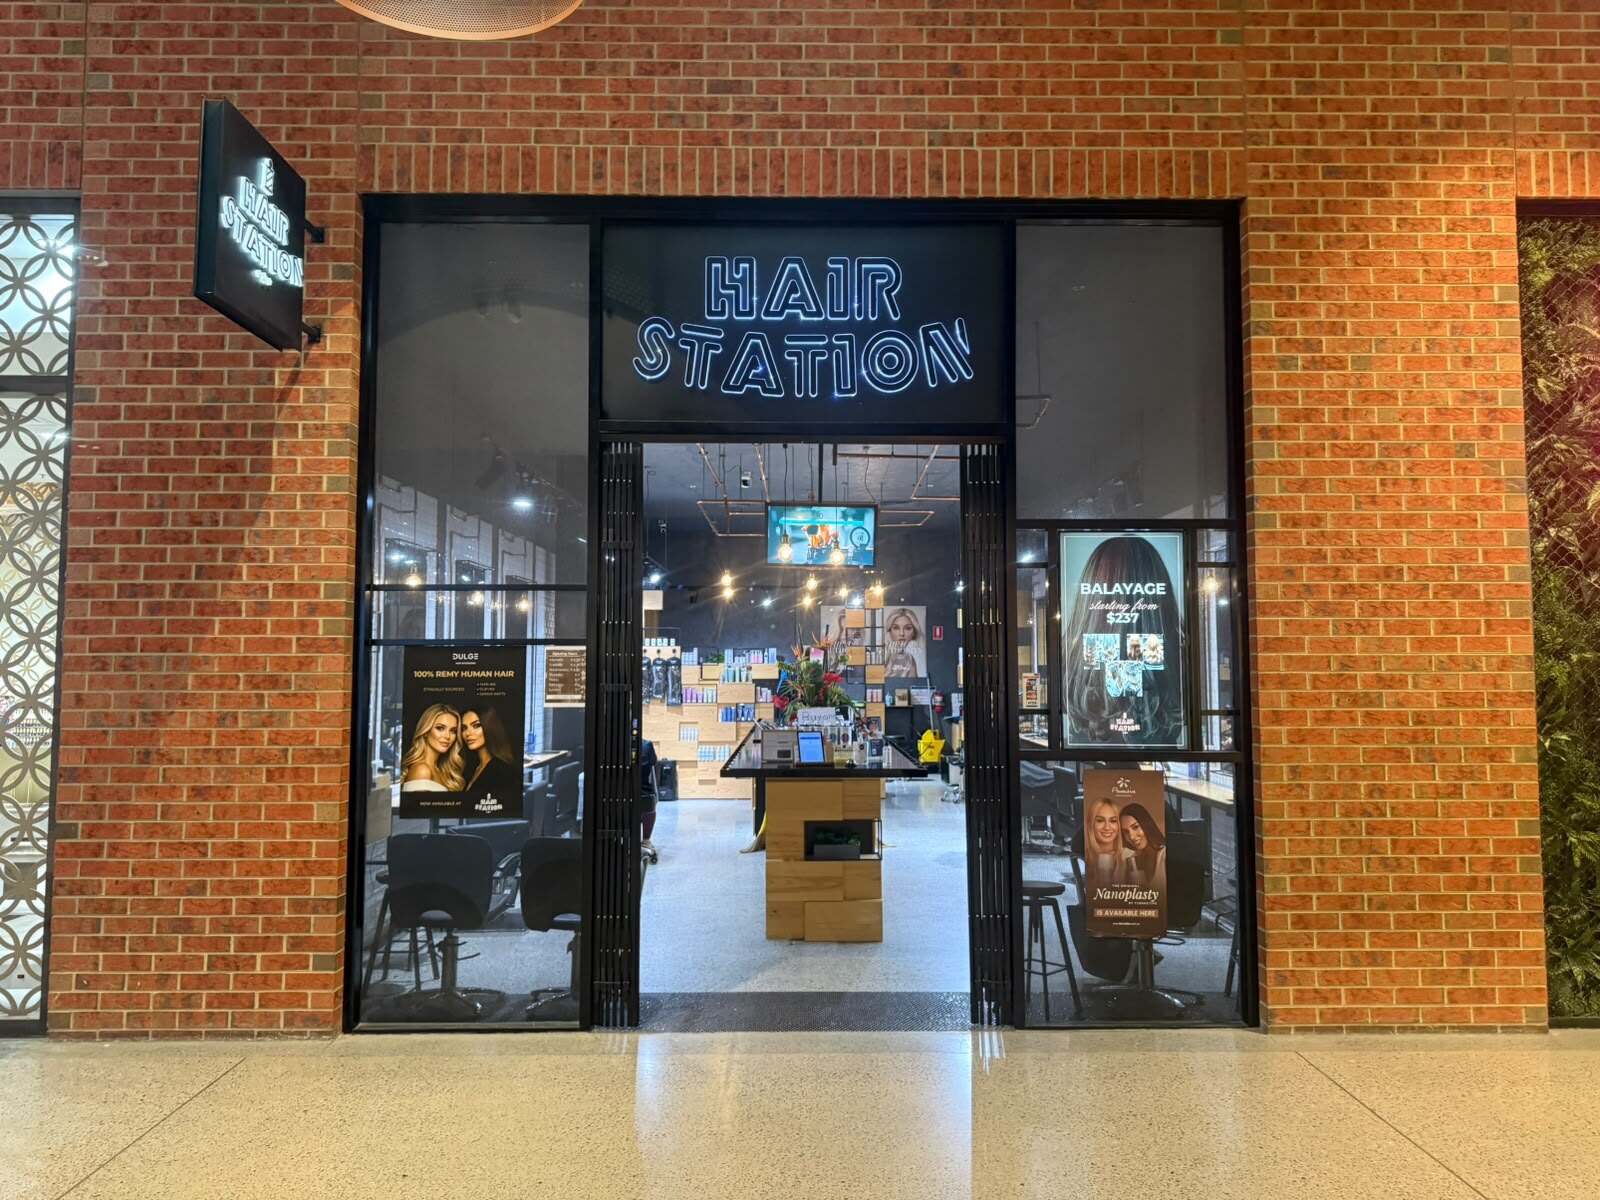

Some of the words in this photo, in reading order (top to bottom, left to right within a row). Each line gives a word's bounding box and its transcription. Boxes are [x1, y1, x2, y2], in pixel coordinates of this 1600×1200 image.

[238, 175, 289, 246] HAIR
[219, 196, 304, 287] STATION
[704, 256, 902, 321] HAIR
[632, 316, 974, 398] STATION
[1080, 583, 1166, 595] BALAYAGE
[1088, 600, 1130, 611] starting
[1131, 598, 1159, 610] from
[1106, 612, 1139, 624] $237
[413, 670, 434, 678] 100%
[435, 670, 460, 678] REMY
[461, 670, 493, 678] HUMAN
[494, 670, 515, 678] HAIR
[1093, 888, 1159, 902] Nanoplasty
